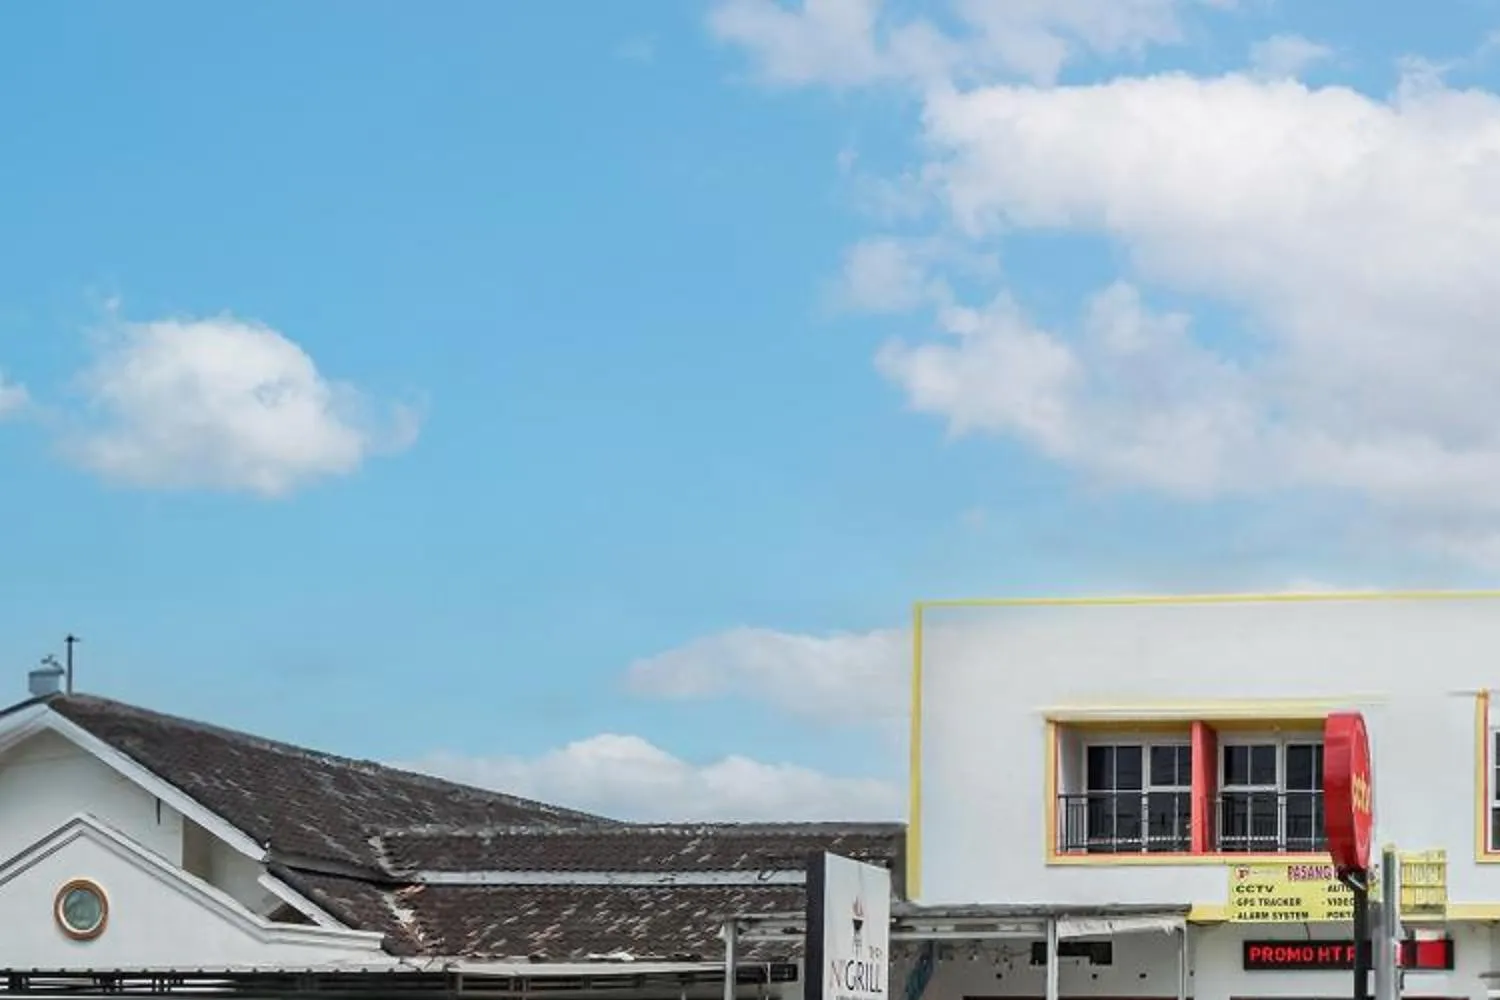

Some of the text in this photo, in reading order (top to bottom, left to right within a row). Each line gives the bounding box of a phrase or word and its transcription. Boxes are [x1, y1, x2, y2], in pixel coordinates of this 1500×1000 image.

[1287, 865, 1332, 881] PASANG
[1235, 884, 1274, 893] CCTV
[1236, 897, 1301, 907] GPS TRACKER
[1237, 911, 1309, 920] ALARM SYSTEM
[1250, 946, 1313, 961] PROMO
[1317, 946, 1340, 961] HT
